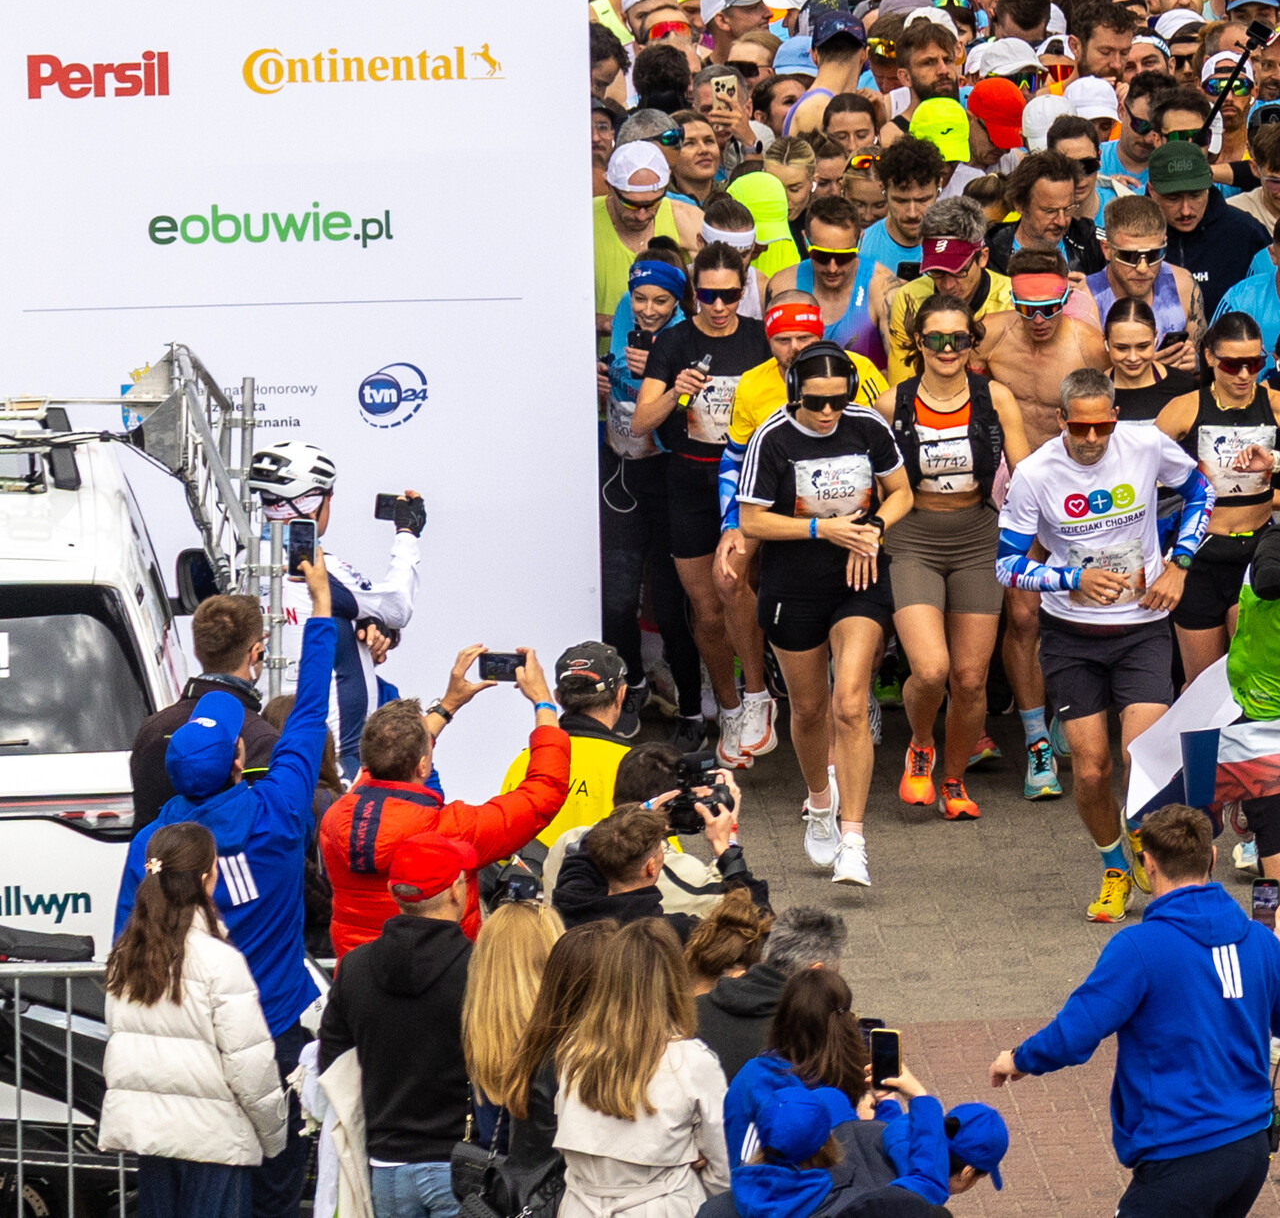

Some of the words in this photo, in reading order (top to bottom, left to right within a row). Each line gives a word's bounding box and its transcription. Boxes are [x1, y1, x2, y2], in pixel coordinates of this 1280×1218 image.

[26, 50, 170, 100] Persil
[241, 46, 466, 95] Continental
[148, 201, 394, 249] eobuwie.pl
[926, 455, 968, 469] 17742
[814, 485, 855, 501] 18232
[1060, 523, 1103, 536] DZIECIAKI
[1105, 510, 1146, 527] CHOJRAKI
[0, 885, 92, 924] llwyn
